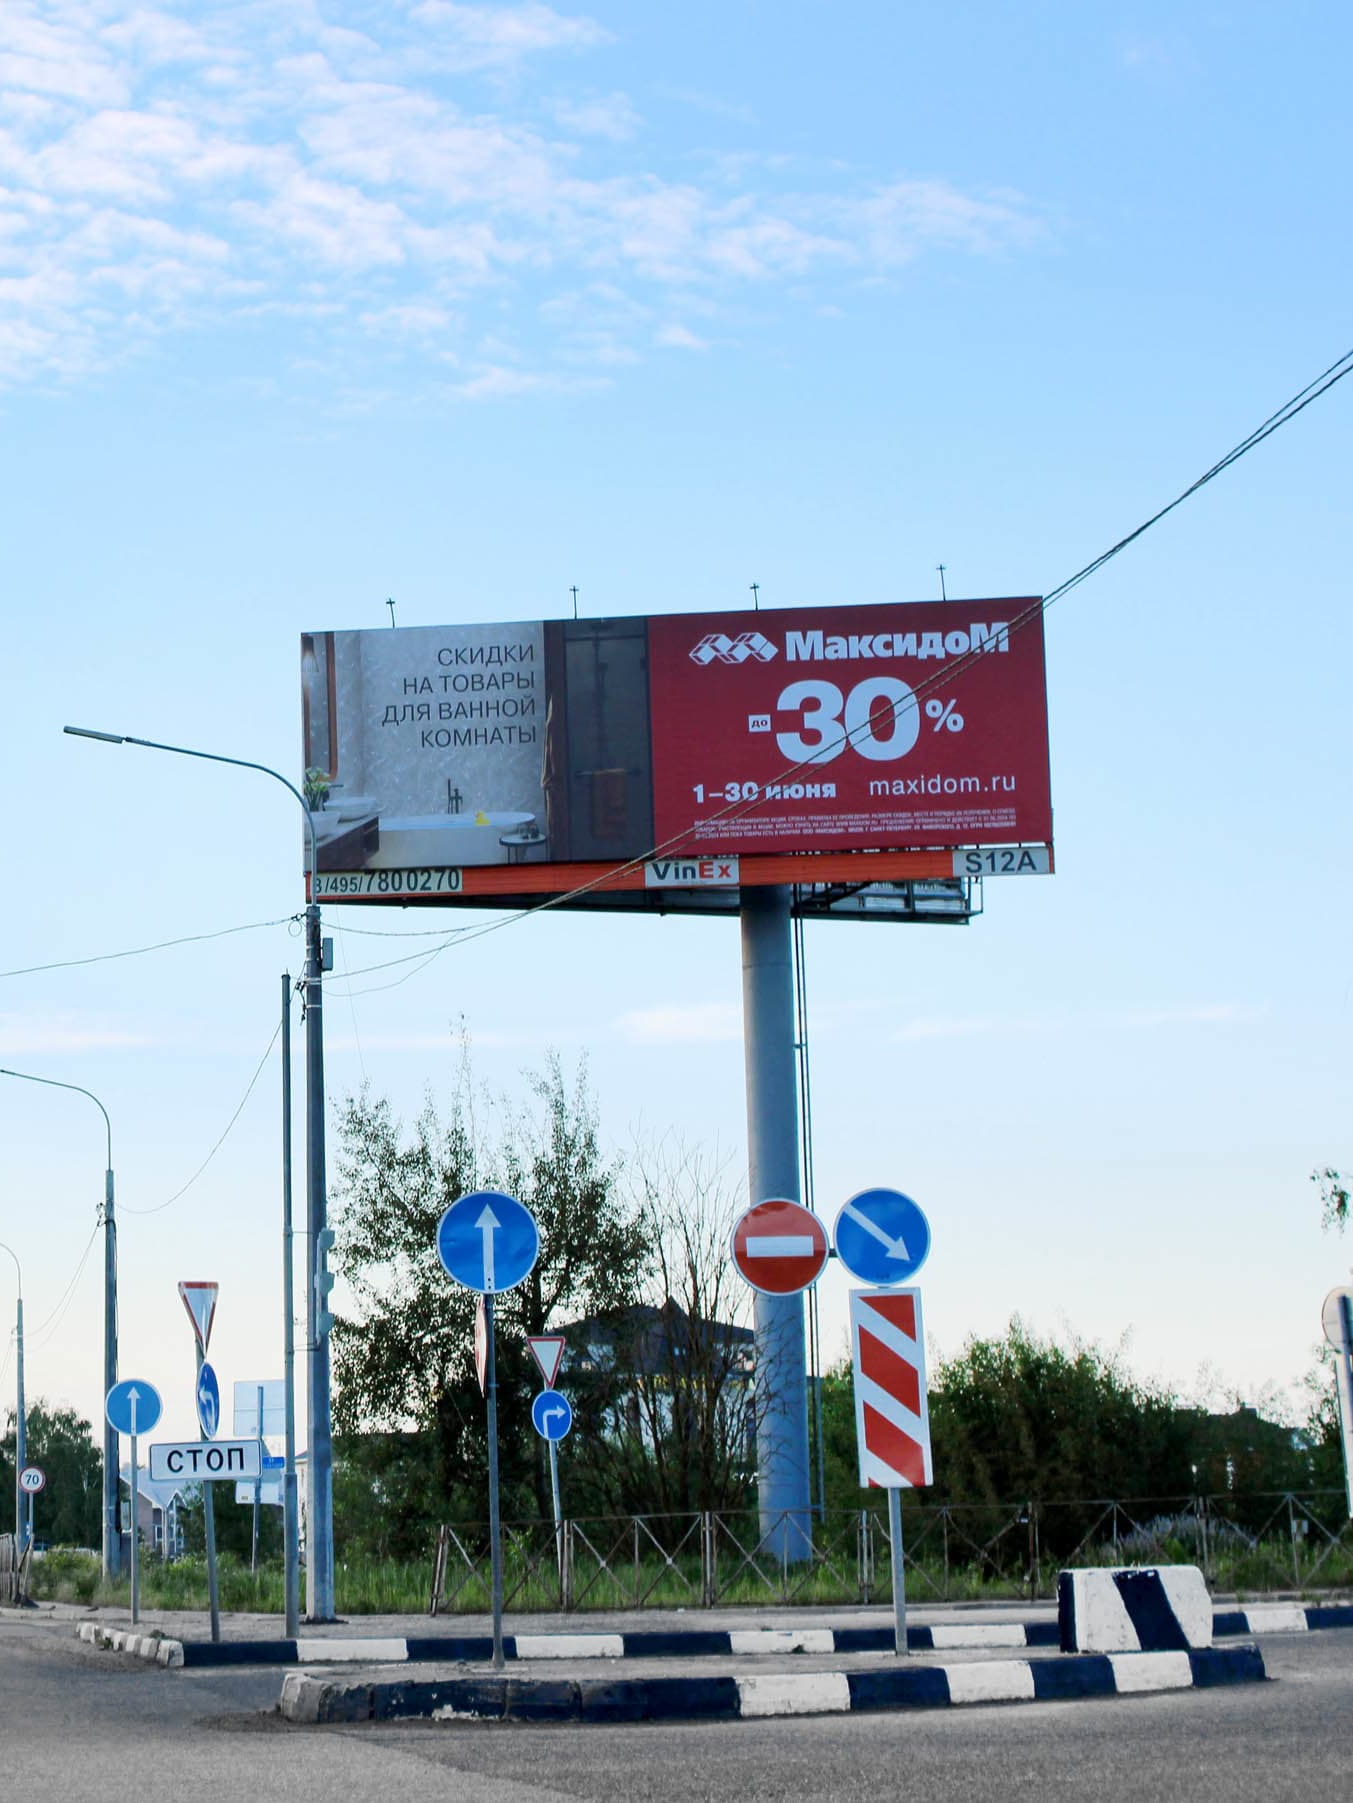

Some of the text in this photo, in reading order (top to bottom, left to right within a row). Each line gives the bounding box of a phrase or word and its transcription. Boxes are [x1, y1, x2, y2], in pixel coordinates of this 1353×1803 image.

[785, 622, 1009, 661] МаксидоМ
[438, 645, 534, 666] СКИДКИ
[403, 671, 535, 695] НА ТОВАРЫ
[382, 695, 535, 727] ДЛЯ ВАННОЙ
[751, 718, 768, 730] до
[421, 725, 536, 748] КОМНАТЫ
[765, 783, 836, 800] июня
[869, 774, 1016, 796] maxidom.ru
[652, 861, 732, 881] VinEx
[966, 850, 1037, 873] S12A
[167, 1448, 244, 1473] СТОП
[25, 1474, 39, 1485] 70
